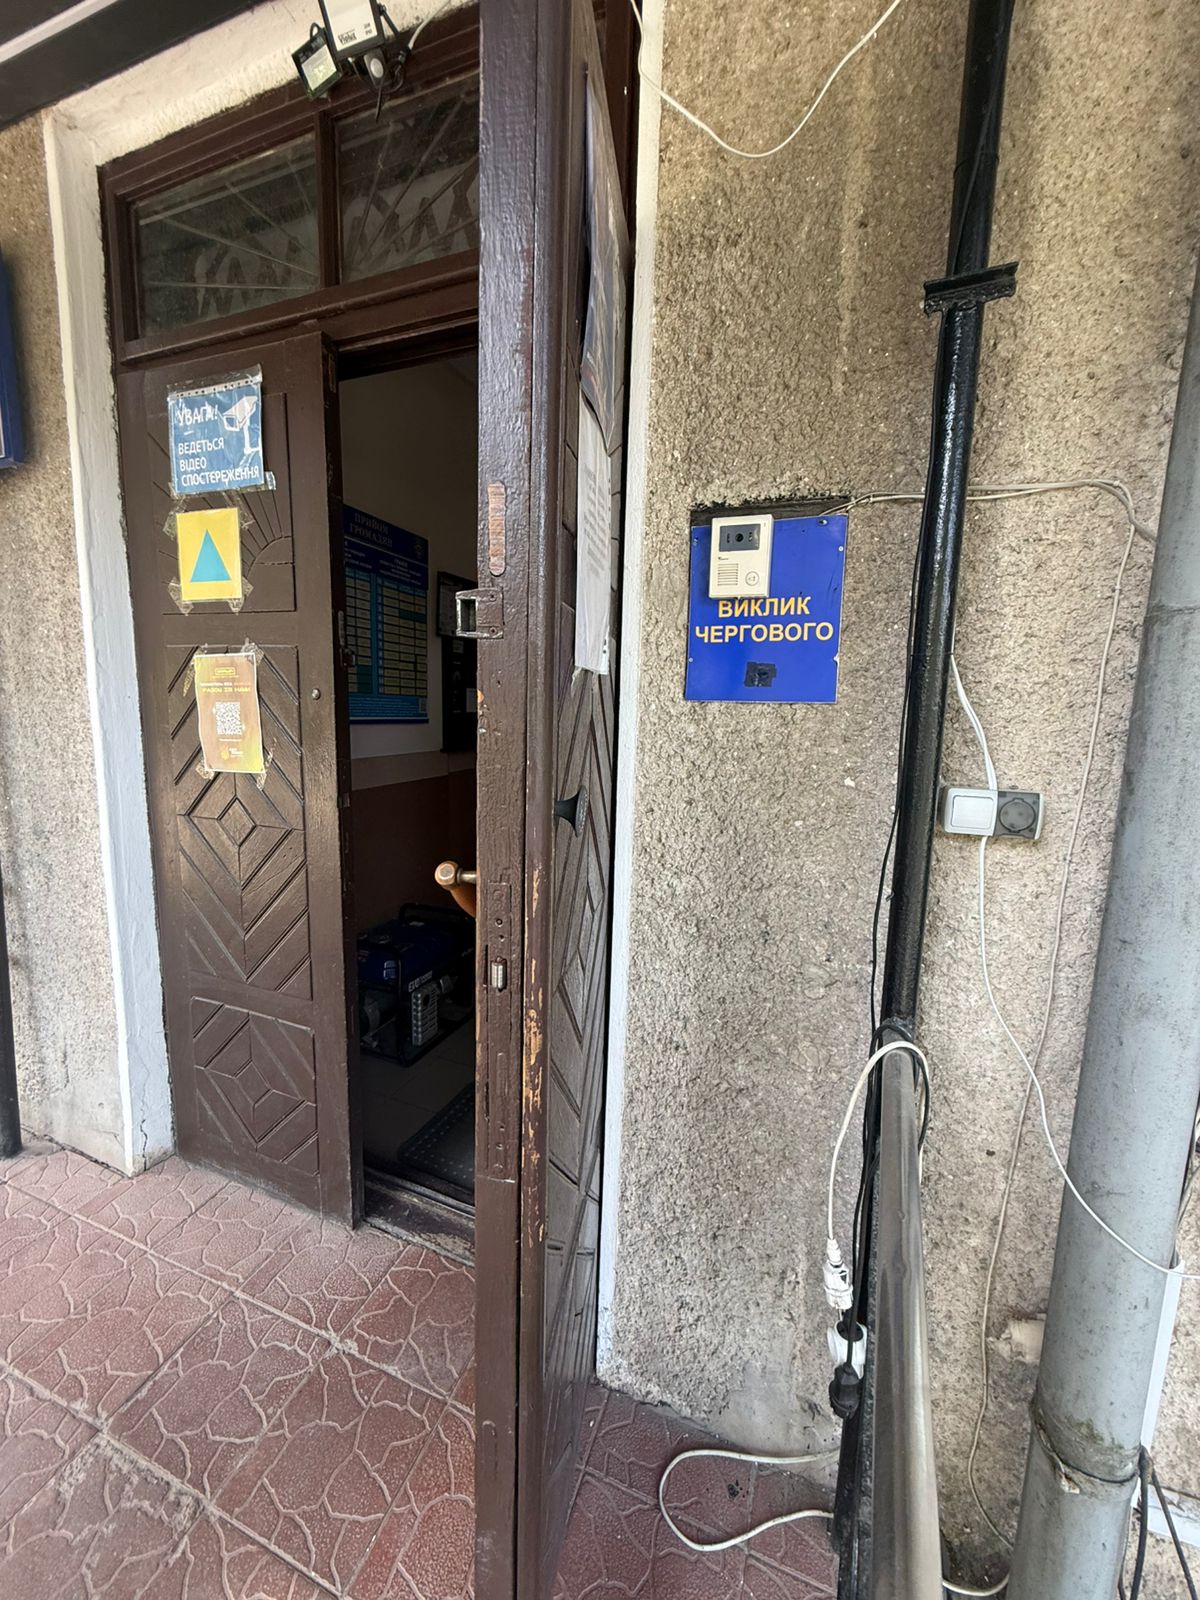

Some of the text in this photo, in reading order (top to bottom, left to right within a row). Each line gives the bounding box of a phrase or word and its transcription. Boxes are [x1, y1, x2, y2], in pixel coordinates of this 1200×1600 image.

[177, 403, 218, 426] УВАГА!
[178, 437, 225, 455] ВЕДЕТЬСЯ
[180, 456, 207, 472] ВІДЕО
[181, 465, 259, 487] СПОСТЕРЕЖЕННЯ
[718, 596, 811, 618] ВИКЛИК
[695, 621, 834, 643] ЧЕРГОВОГО
